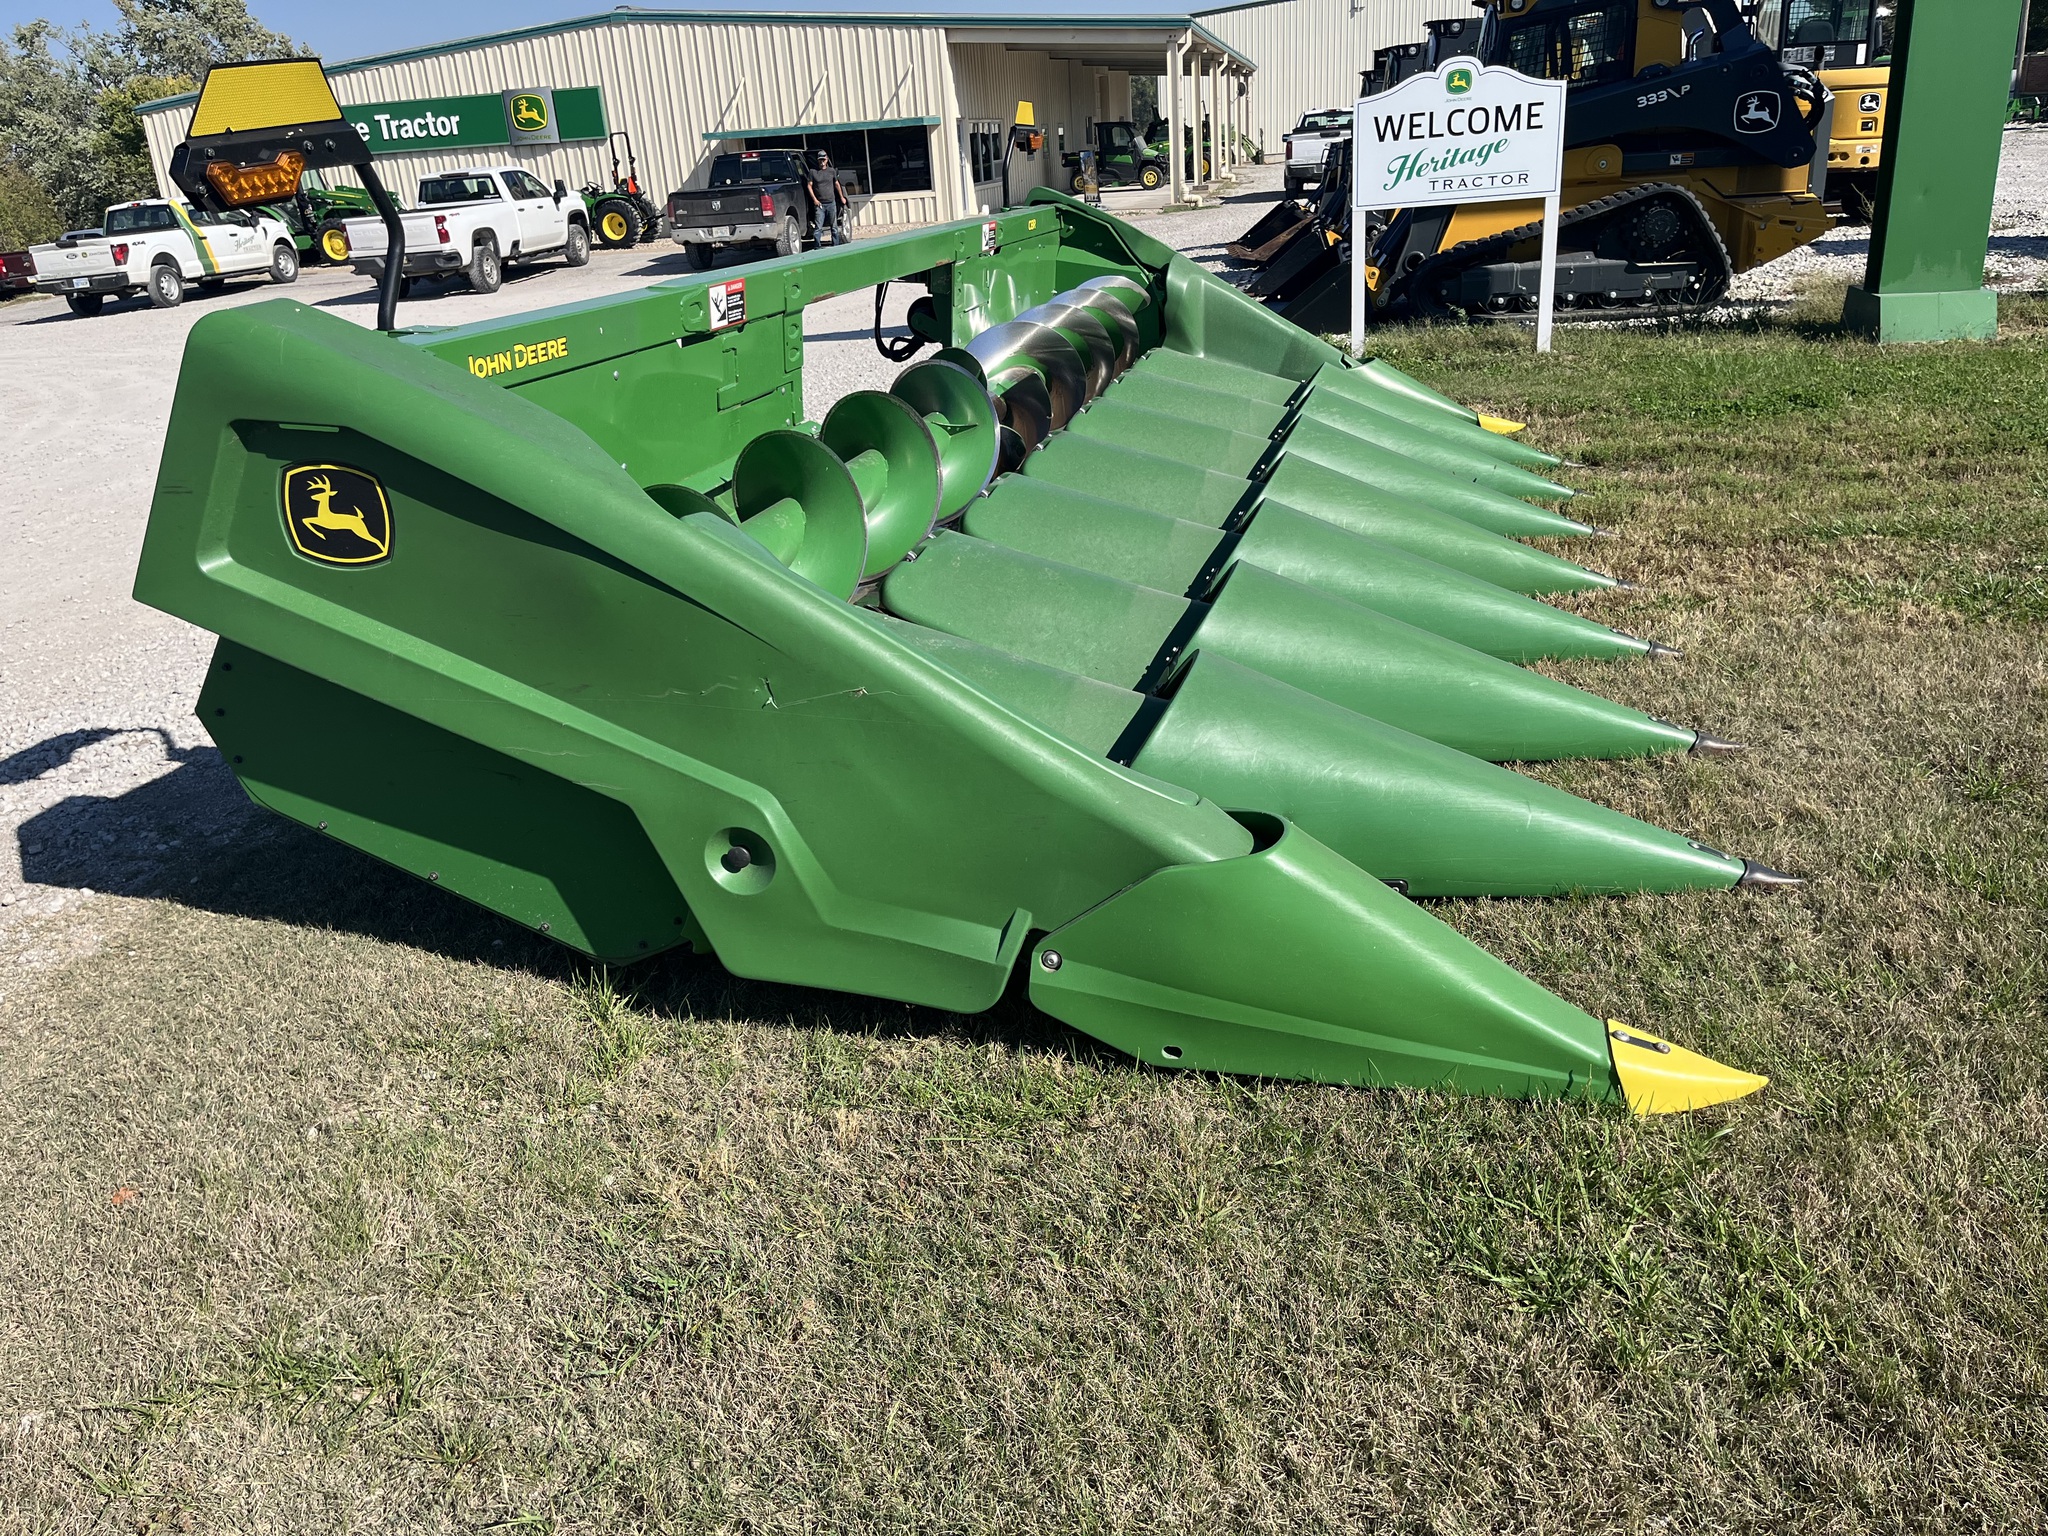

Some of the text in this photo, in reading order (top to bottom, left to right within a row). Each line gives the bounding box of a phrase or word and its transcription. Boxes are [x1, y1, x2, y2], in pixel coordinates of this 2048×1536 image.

[374, 111, 460, 140] Tractor
[1373, 101, 1545, 143] WELCOME
[1383, 138, 1510, 191] Heritage
[1429, 173, 1529, 191] TRACTOR
[468, 336, 569, 379] JOHN DEERE
